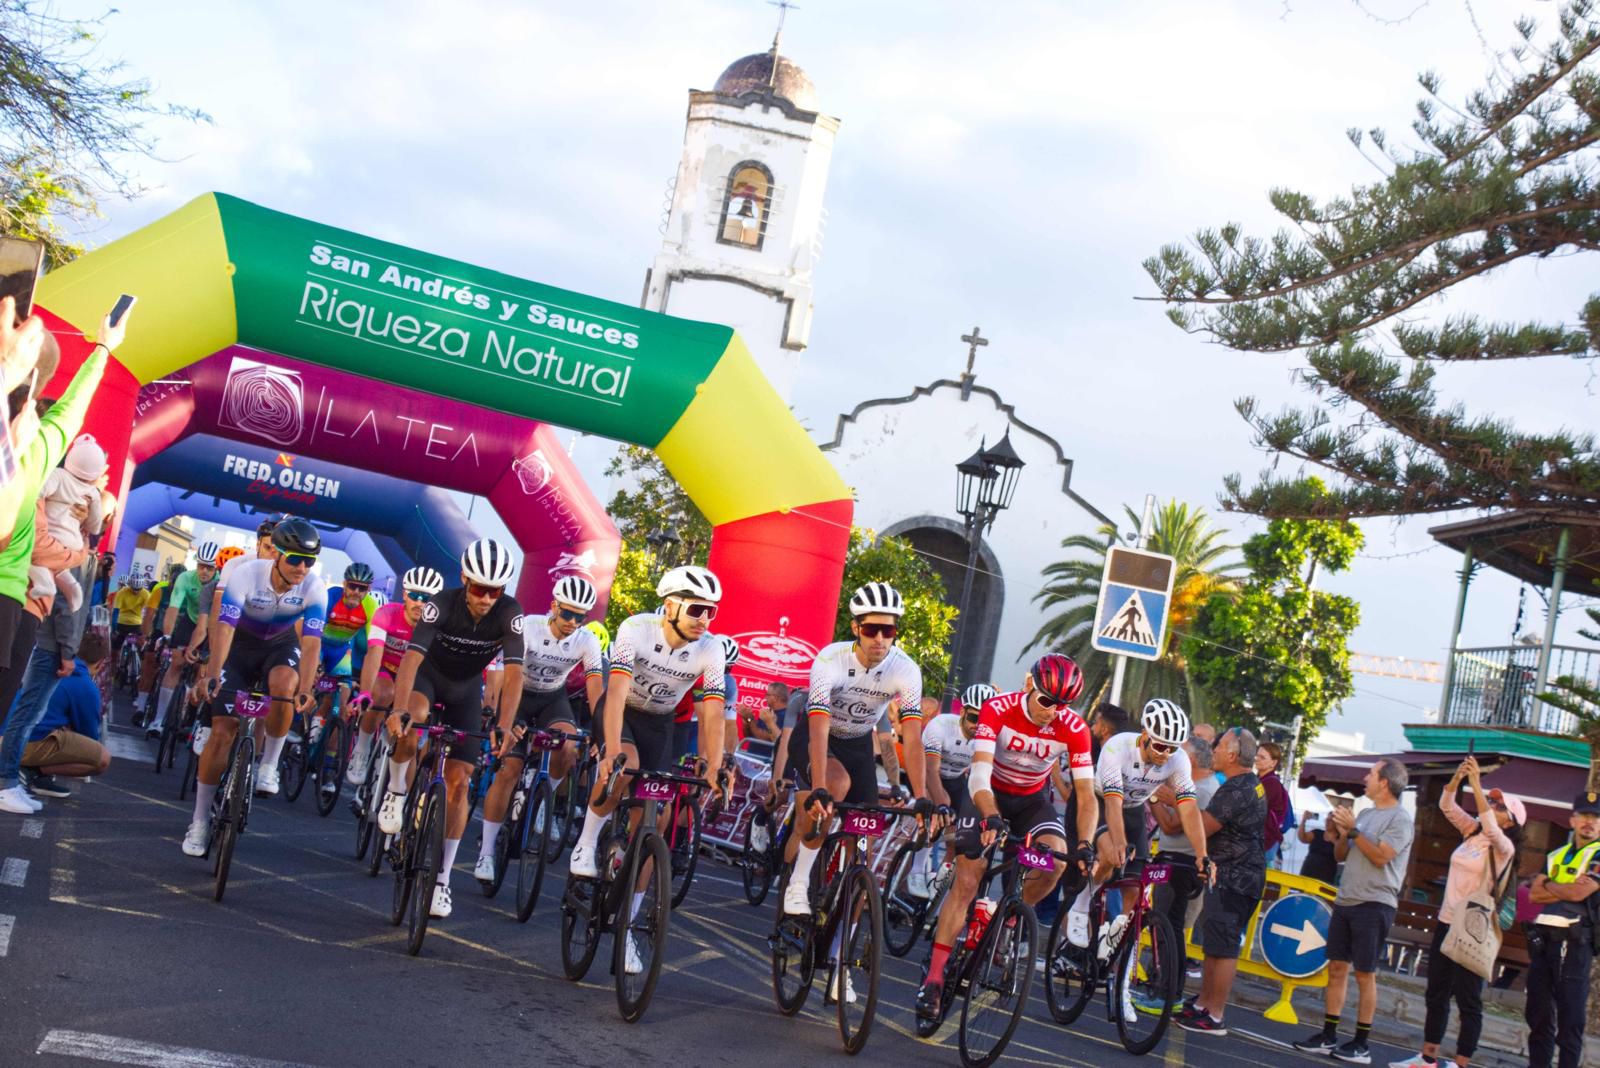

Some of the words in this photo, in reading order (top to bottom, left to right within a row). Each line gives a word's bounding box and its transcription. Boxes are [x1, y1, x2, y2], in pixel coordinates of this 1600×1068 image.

[309, 245, 370, 278] San
[379, 266, 491, 310] Andrés
[498, 300, 520, 321] y
[527, 304, 640, 350] Sauces
[299, 281, 470, 358] Riqueza
[481, 330, 632, 399] Natural
[323, 398, 379, 445] LA
[396, 415, 480, 468] TEA
[651, 664, 696, 679] FOGUEO
[848, 686, 890, 698] FOGUEO
[241, 700, 265, 712] 157
[988, 694, 1019, 716] RIU
[1057, 709, 1087, 734] RIU
[643, 782, 670, 794] 104
[852, 817, 877, 830] 103
[1024, 852, 1048, 866] 106
